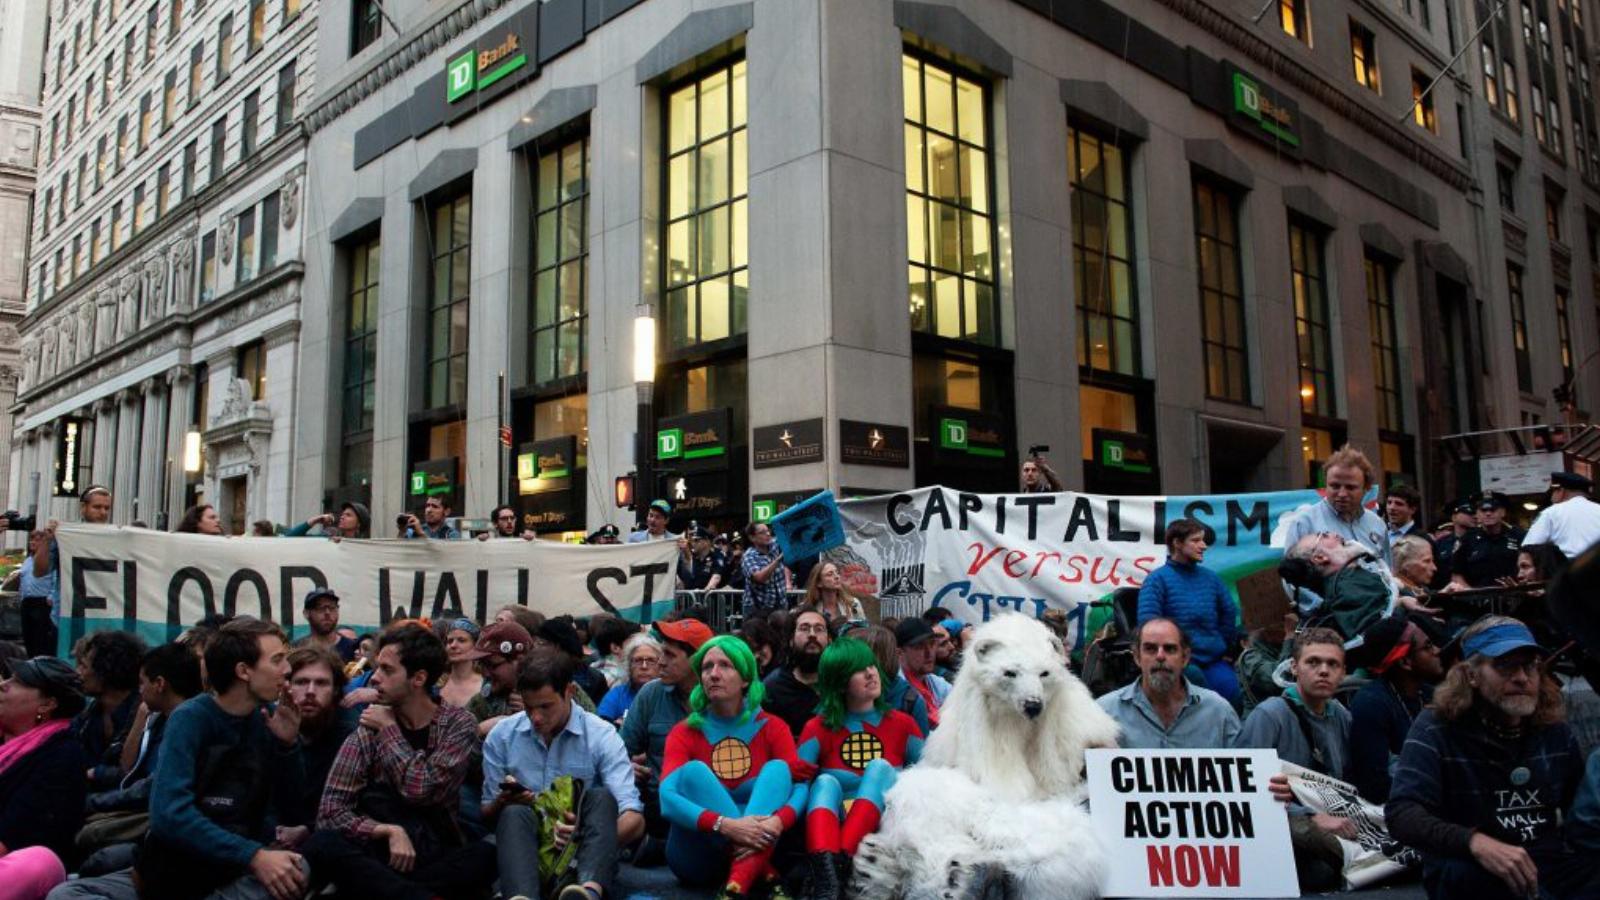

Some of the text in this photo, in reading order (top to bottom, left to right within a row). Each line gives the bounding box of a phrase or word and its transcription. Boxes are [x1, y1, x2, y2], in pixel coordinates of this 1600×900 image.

[450, 32, 518, 92] TD Bank
[1240, 81, 1259, 111] TD
[659, 428, 718, 453] TD Bank
[948, 424, 965, 443] TD
[754, 505, 770, 520] TD
[886, 487, 1272, 547] CAPITALISM
[965, 542, 1158, 588] versus
[586, 561, 670, 624] ST
[1110, 756, 1257, 793] CLIMATE
[1494, 788, 1541, 808] TAX
[1123, 800, 1255, 839] ACTION
[1146, 844, 1241, 888] NOW
